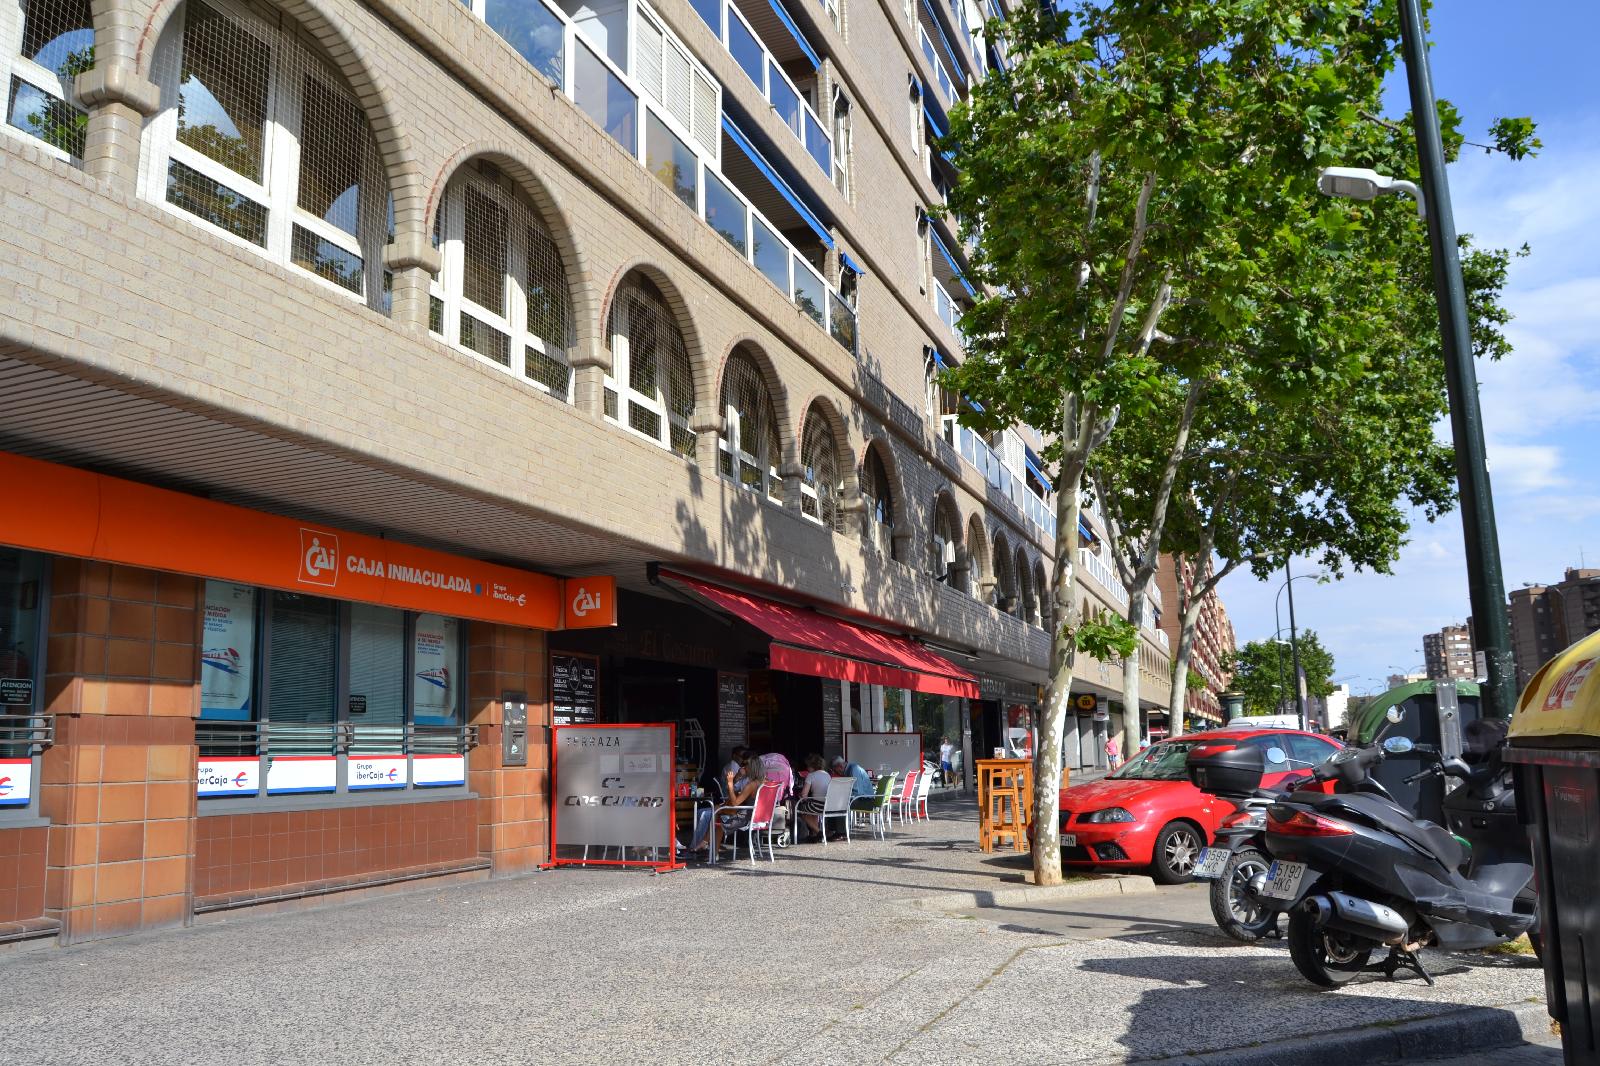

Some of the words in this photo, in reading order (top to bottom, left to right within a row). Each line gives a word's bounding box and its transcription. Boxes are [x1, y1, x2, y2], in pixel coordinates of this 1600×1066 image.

[346, 556, 385, 577] CAJA
[388, 564, 472, 593] INMACULADA
[566, 736, 621, 747] TERRAZA
[356, 771, 384, 781] iberCaja
[1205, 850, 1229, 861] 0599
[1276, 863, 1303, 878] 5190
[1273, 879, 1292, 892] HKG
